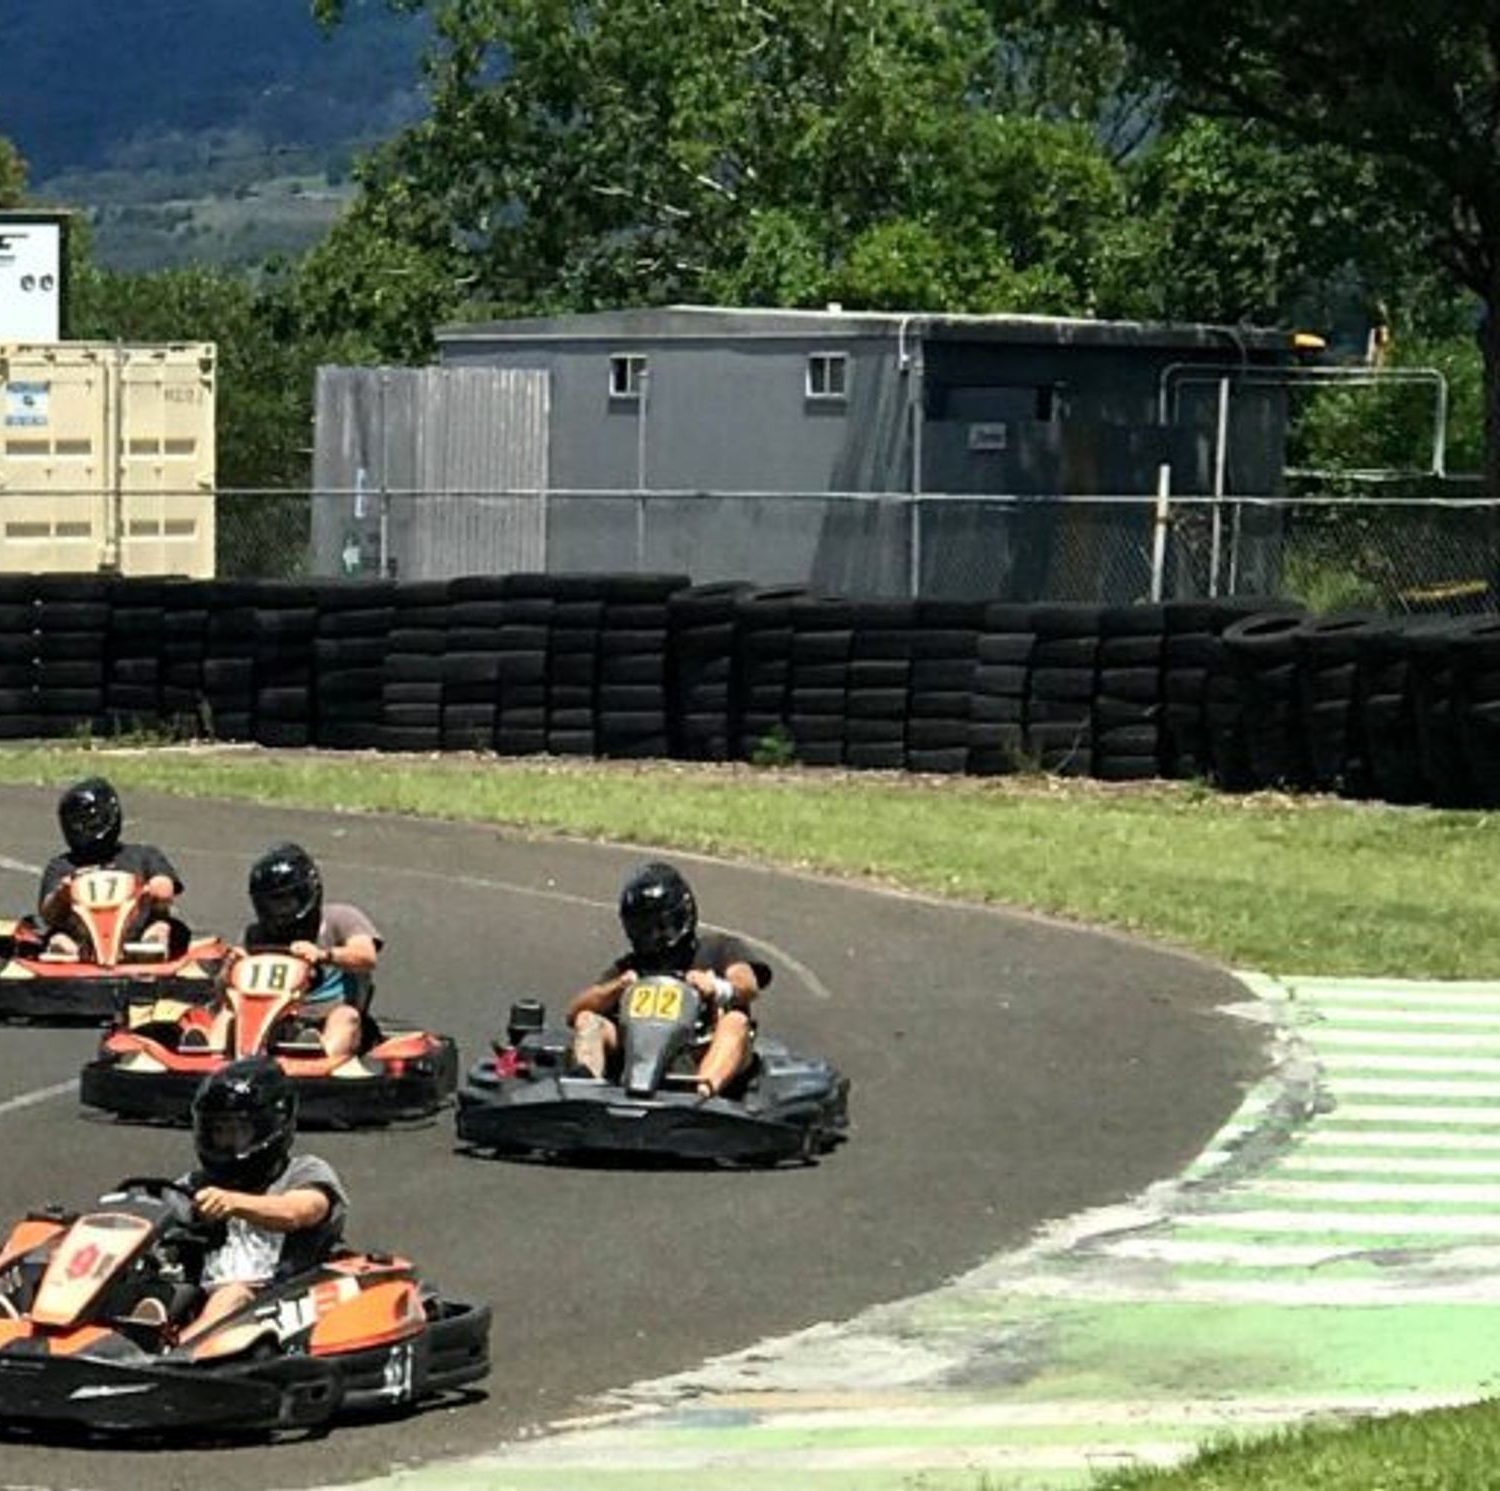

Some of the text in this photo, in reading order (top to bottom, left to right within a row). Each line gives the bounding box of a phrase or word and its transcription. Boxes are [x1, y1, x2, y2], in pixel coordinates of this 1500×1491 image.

[88, 876, 118, 902] 17
[248, 963, 288, 991] 18
[634, 988, 677, 1014] 22
